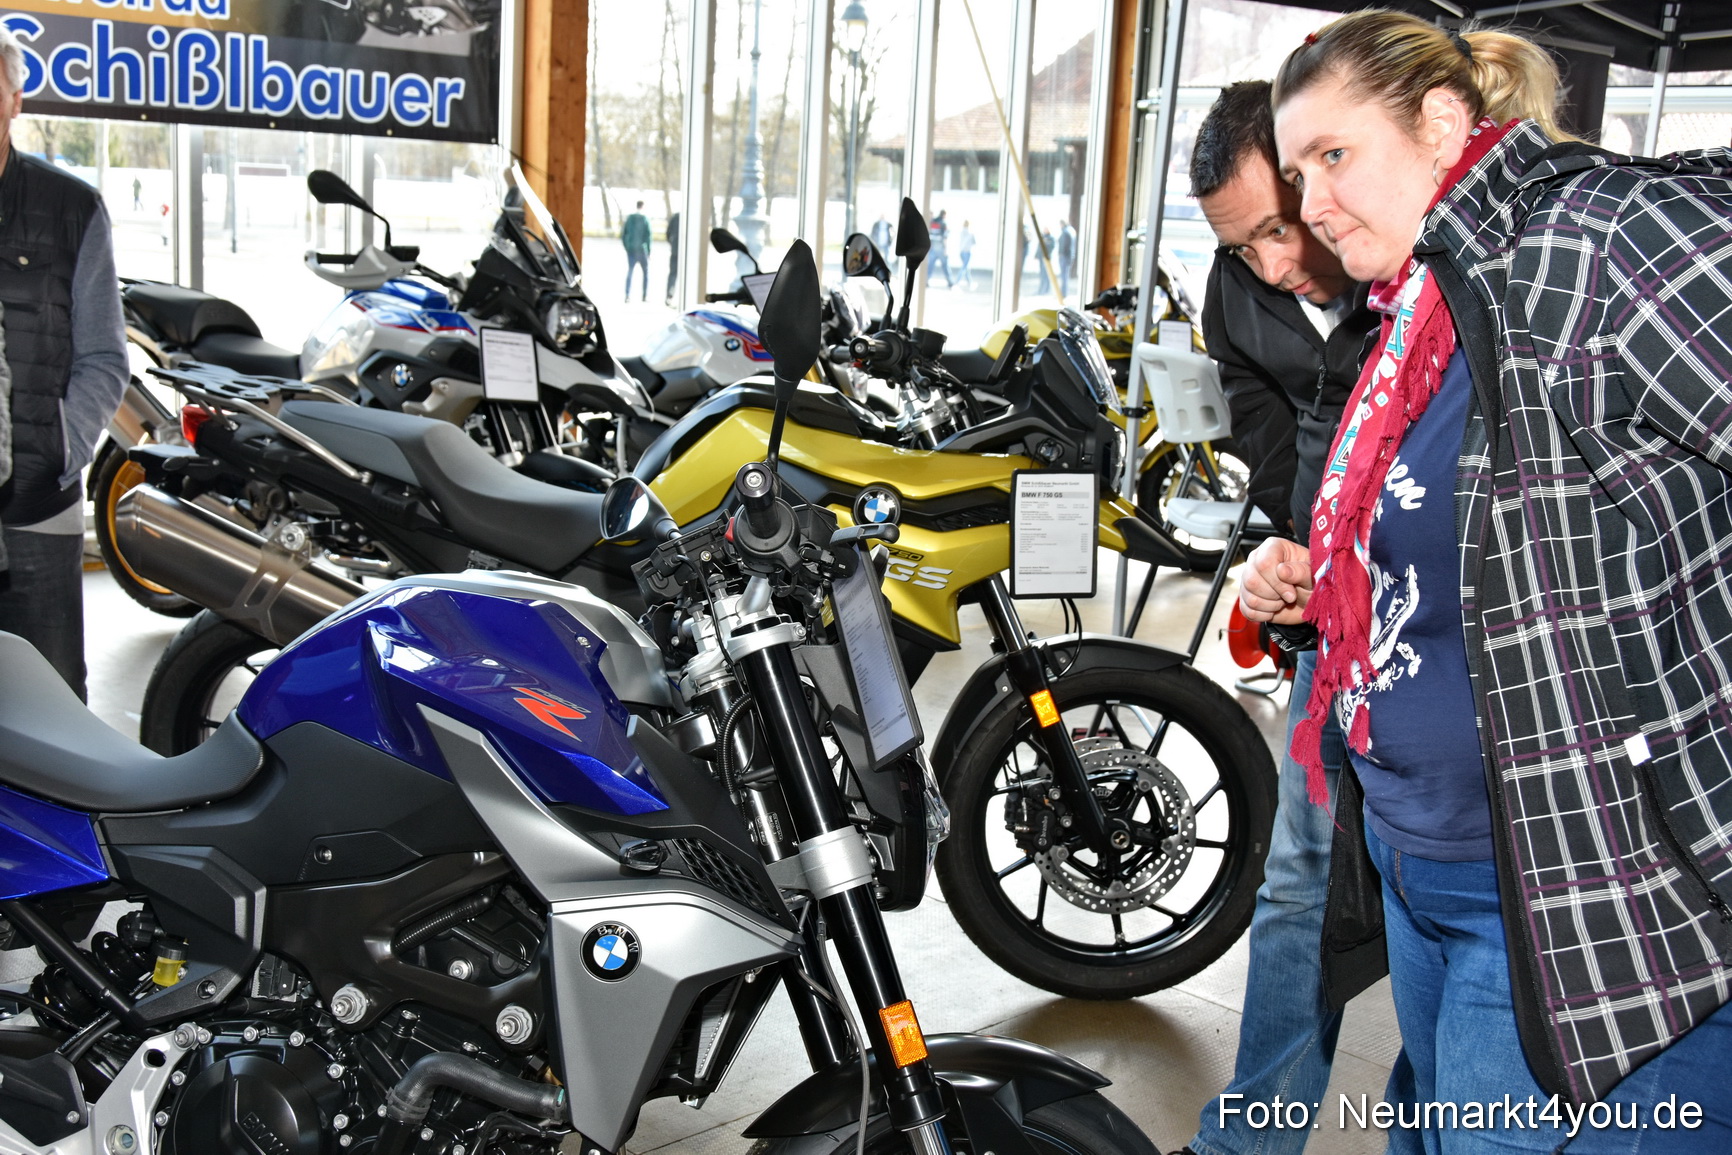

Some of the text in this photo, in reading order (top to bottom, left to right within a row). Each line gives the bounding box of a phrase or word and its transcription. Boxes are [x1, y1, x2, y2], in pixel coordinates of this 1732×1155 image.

[1, 13, 465, 127] Schißlbauer
[884, 557, 954, 590] GS
[597, 925, 639, 952] BMW
